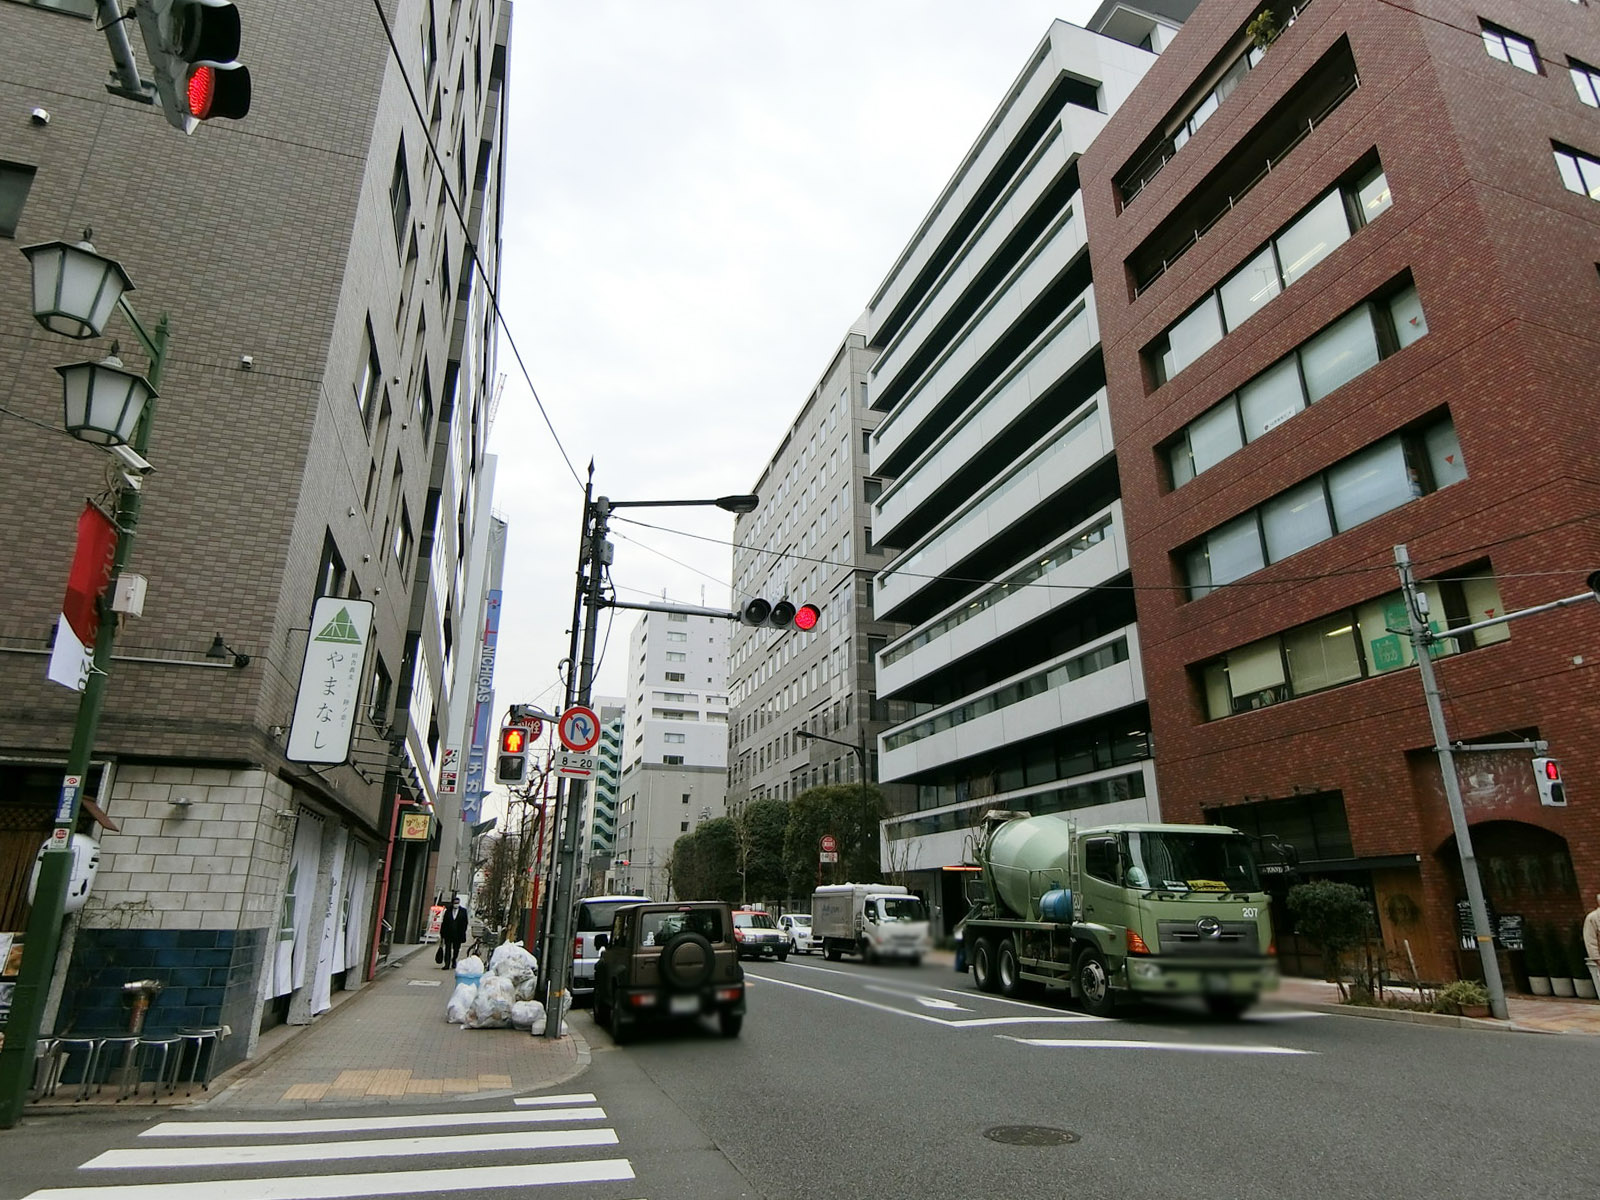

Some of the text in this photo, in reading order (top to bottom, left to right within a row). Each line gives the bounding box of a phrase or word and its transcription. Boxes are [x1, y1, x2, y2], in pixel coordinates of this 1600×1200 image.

[313, 651, 344, 749] やまなし
[477, 645, 496, 703] NICHIGAS
[463, 744, 484, 812] ニチガス
[1242, 908, 1258, 918] 207
